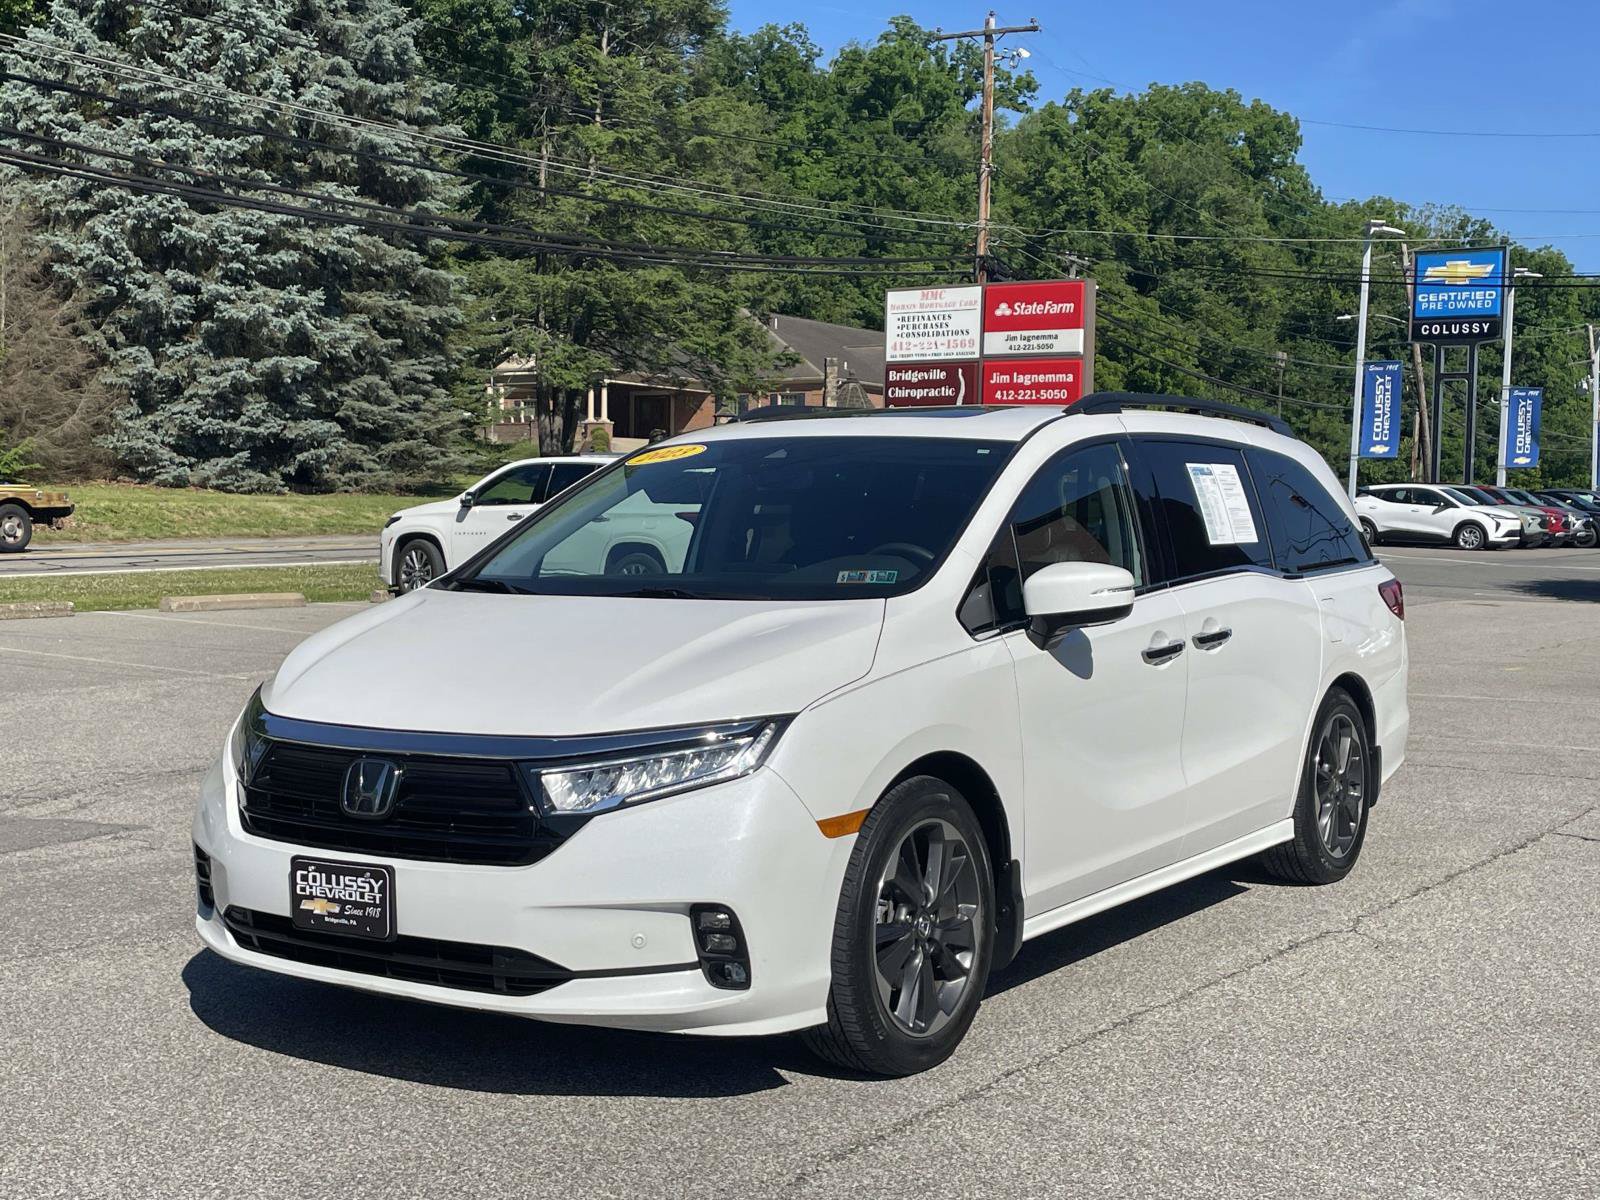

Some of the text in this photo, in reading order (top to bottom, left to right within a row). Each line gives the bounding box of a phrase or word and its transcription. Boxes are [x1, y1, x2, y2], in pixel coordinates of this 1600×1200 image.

[920, 290, 946, 300] MMC
[1418, 291, 1496, 302] CERTIFIED
[1421, 300, 1492, 310] PRE-OWNED
[901, 314, 952, 323] REFINANCES
[900, 322, 949, 331] PURCHASES
[1421, 323, 1490, 335] COLUSSY
[900, 329, 970, 339] CONSOLIDATIONS
[1005, 334, 1018, 342] Jim
[891, 338, 975, 351] 412-221-1569
[1008, 343, 1054, 351] 412-221-5050
[889, 369, 947, 383] Bridgeville
[990, 372, 1010, 384] Jim
[888, 386, 956, 400] Chiropractic
[995, 389, 1068, 400] 412-221-5050
[1373, 375, 1385, 441] COLUSSY
[1382, 375, 1392, 441] CHEVROLET
[1516, 399, 1526, 454] COLUSSY
[1525, 399, 1533, 454] CHEVROLET
[296, 870, 383, 894] COLUSSY
[296, 884, 382, 904] CHEVROLET
[344, 905, 381, 918] Since 1918
